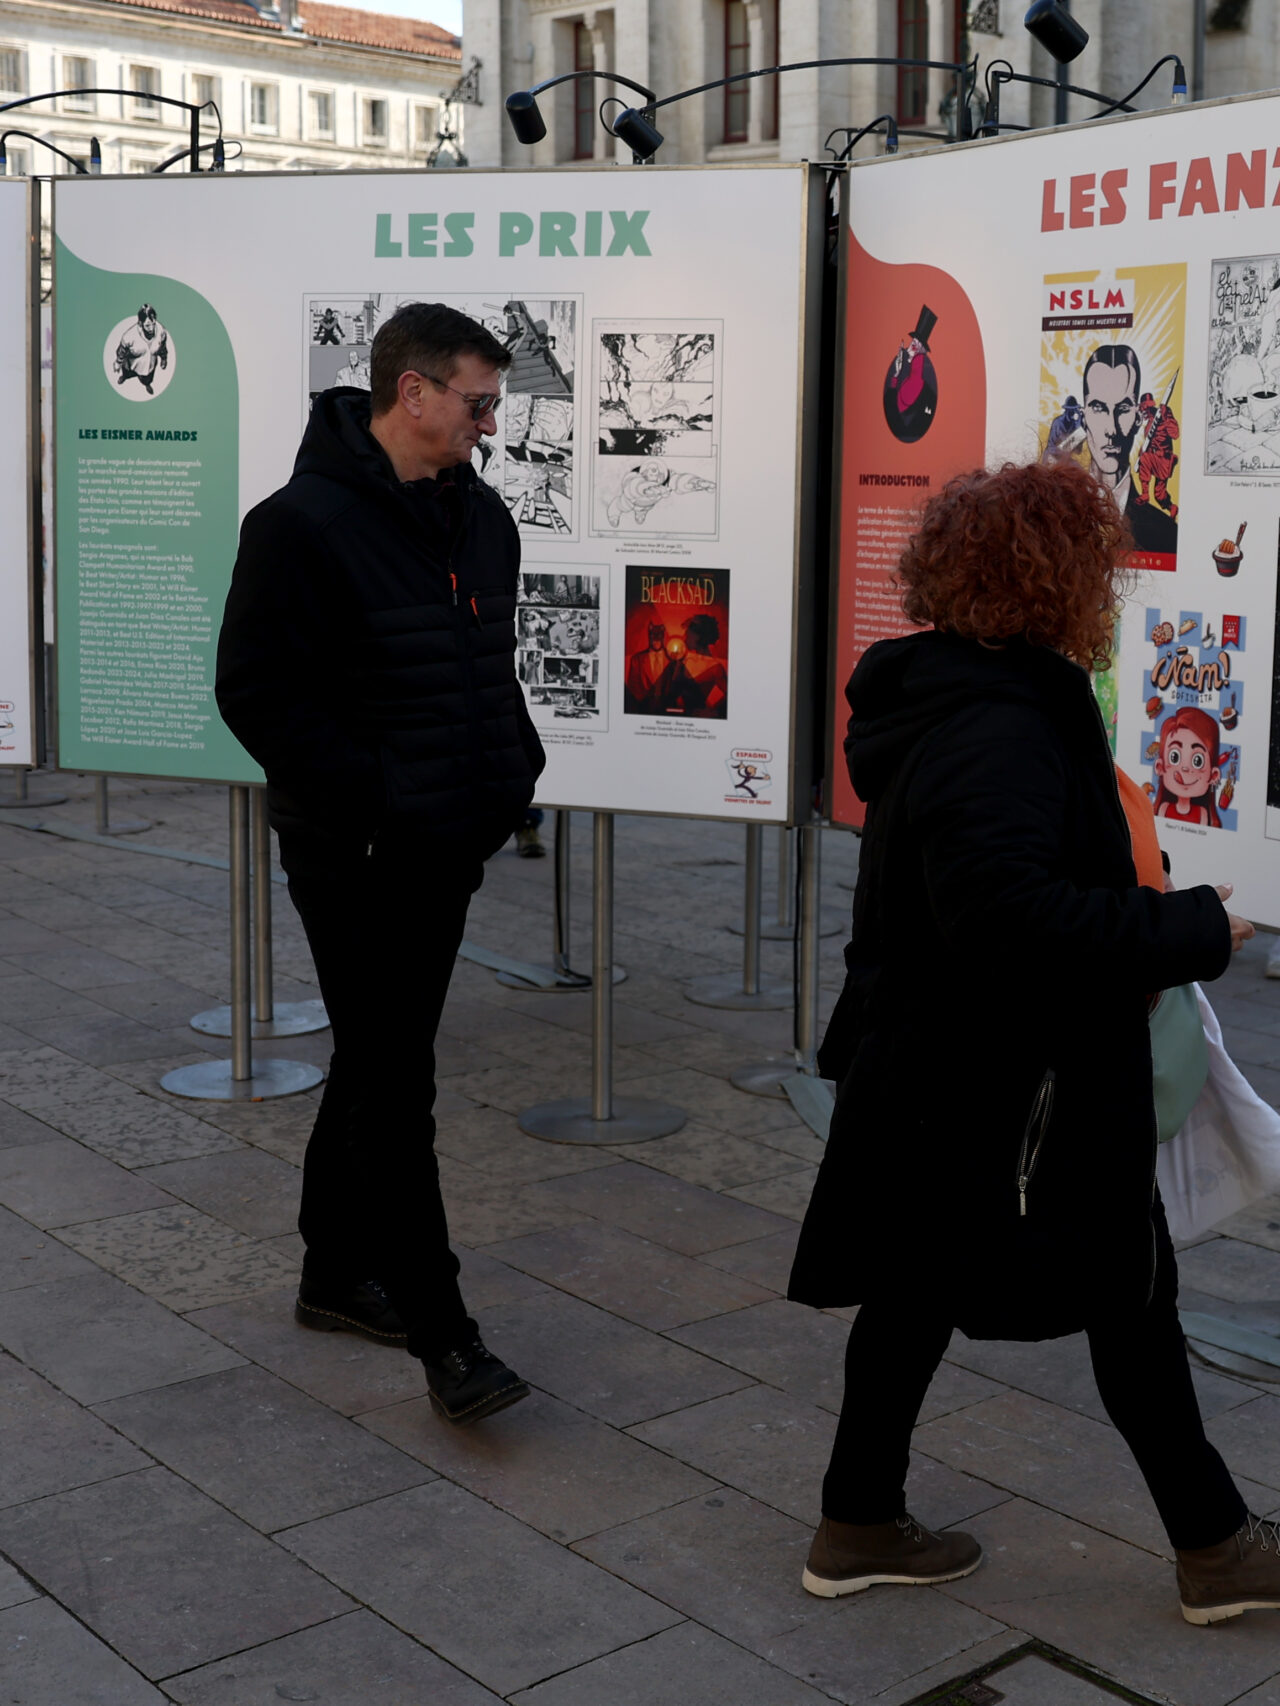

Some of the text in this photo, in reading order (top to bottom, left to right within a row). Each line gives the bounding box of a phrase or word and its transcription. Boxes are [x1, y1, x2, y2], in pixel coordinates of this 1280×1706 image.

[1041, 168, 1128, 232] LES
[374, 210, 653, 258] LES PRIX
[1049, 288, 1125, 311] NSLM
[79, 429, 197, 441] LES EISNER AWARDS
[78, 456, 86, 464] La
[86, 456, 107, 466] grande
[126, 457, 134, 465] de
[135, 457, 170, 466] dessinateurs
[171, 458, 201, 468] espagnols
[88, 466, 93, 474] le
[94, 466, 116, 474] marché
[117, 467, 162, 475] nord-américain
[163, 468, 188, 476] remonte
[90, 476, 112, 484] années
[131, 477, 144, 485] Leur
[145, 477, 161, 485] talent
[162, 478, 174, 486] leur
[181, 478, 200, 486] ouvert
[859, 474, 930, 487] INTRODUCTION
[87, 486, 105, 495] portes
[107, 486, 117, 494] des
[118, 487, 142, 496] grandes
[143, 487, 167, 495] maisons
[78, 495, 89, 503] des
[151, 497, 184, 507] témoignent
[185, 498, 194, 506] les
[78, 505, 106, 514] nombreux
[107, 506, 119, 516] prix
[138, 507, 148, 516] qui
[148, 507, 160, 515] leur
[174, 508, 201, 516] décernés
[79, 517, 89, 525] par
[90, 515, 98, 523] les
[99, 516, 138, 526] organisateurs
[139, 517, 147, 525] du
[148, 517, 167, 525] Comic
[181, 518, 190, 526] de
[79, 525, 90, 533] San
[640, 575, 715, 606] BLACKSAD
[735, 751, 768, 760] ESPAGNE
